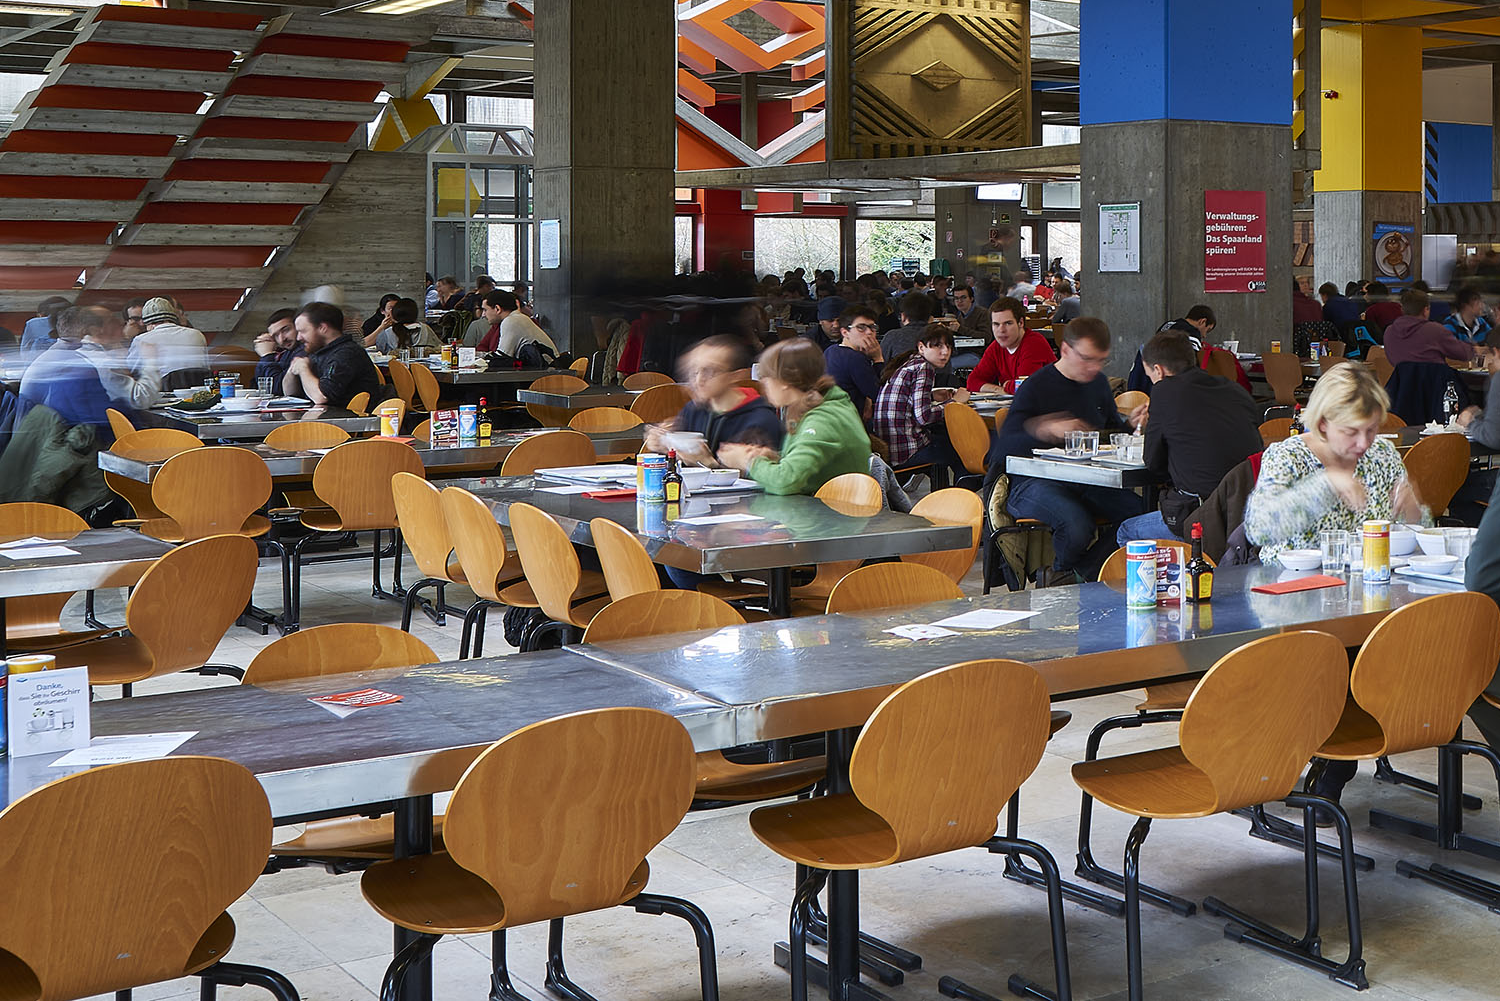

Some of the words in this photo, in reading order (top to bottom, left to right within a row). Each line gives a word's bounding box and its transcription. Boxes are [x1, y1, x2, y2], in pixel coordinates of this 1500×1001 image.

[1206, 212, 1259, 222] Verwaltungs-
[1206, 223, 1247, 233] gebühren:
[1206, 235, 1221, 243] Das
[1222, 235, 1262, 244] Spaarland
[1206, 246, 1236, 256] spüren!
[36, 683, 64, 691] Danke,
[50, 689, 81, 697] Geschirr
